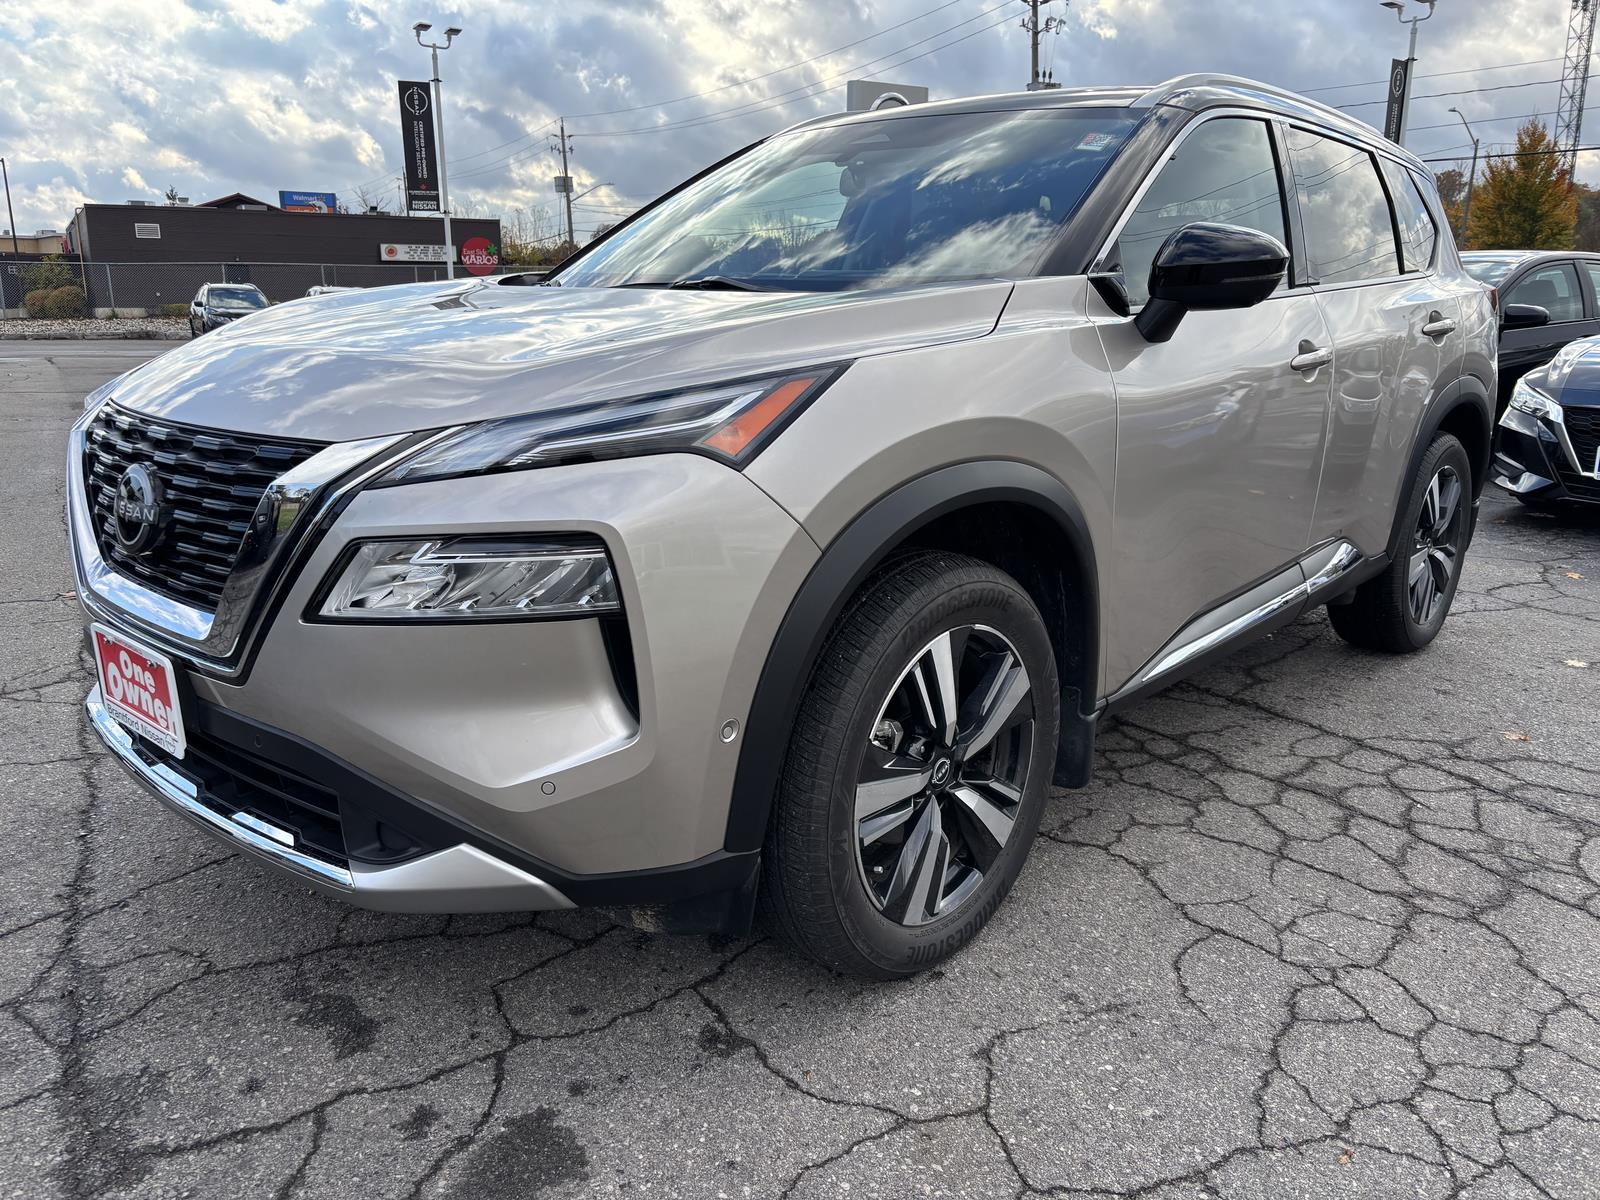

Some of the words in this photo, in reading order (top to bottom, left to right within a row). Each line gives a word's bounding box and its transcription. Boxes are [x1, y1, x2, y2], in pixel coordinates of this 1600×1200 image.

[292, 194, 317, 202] Walmart
[119, 501, 154, 521] SSAN
[119, 650, 156, 694] One
[107, 661, 177, 737] Owner
[107, 703, 140, 731] Brantford
[140, 723, 166, 748] Nissan
[906, 879, 1010, 965] BRIDGESTONE
